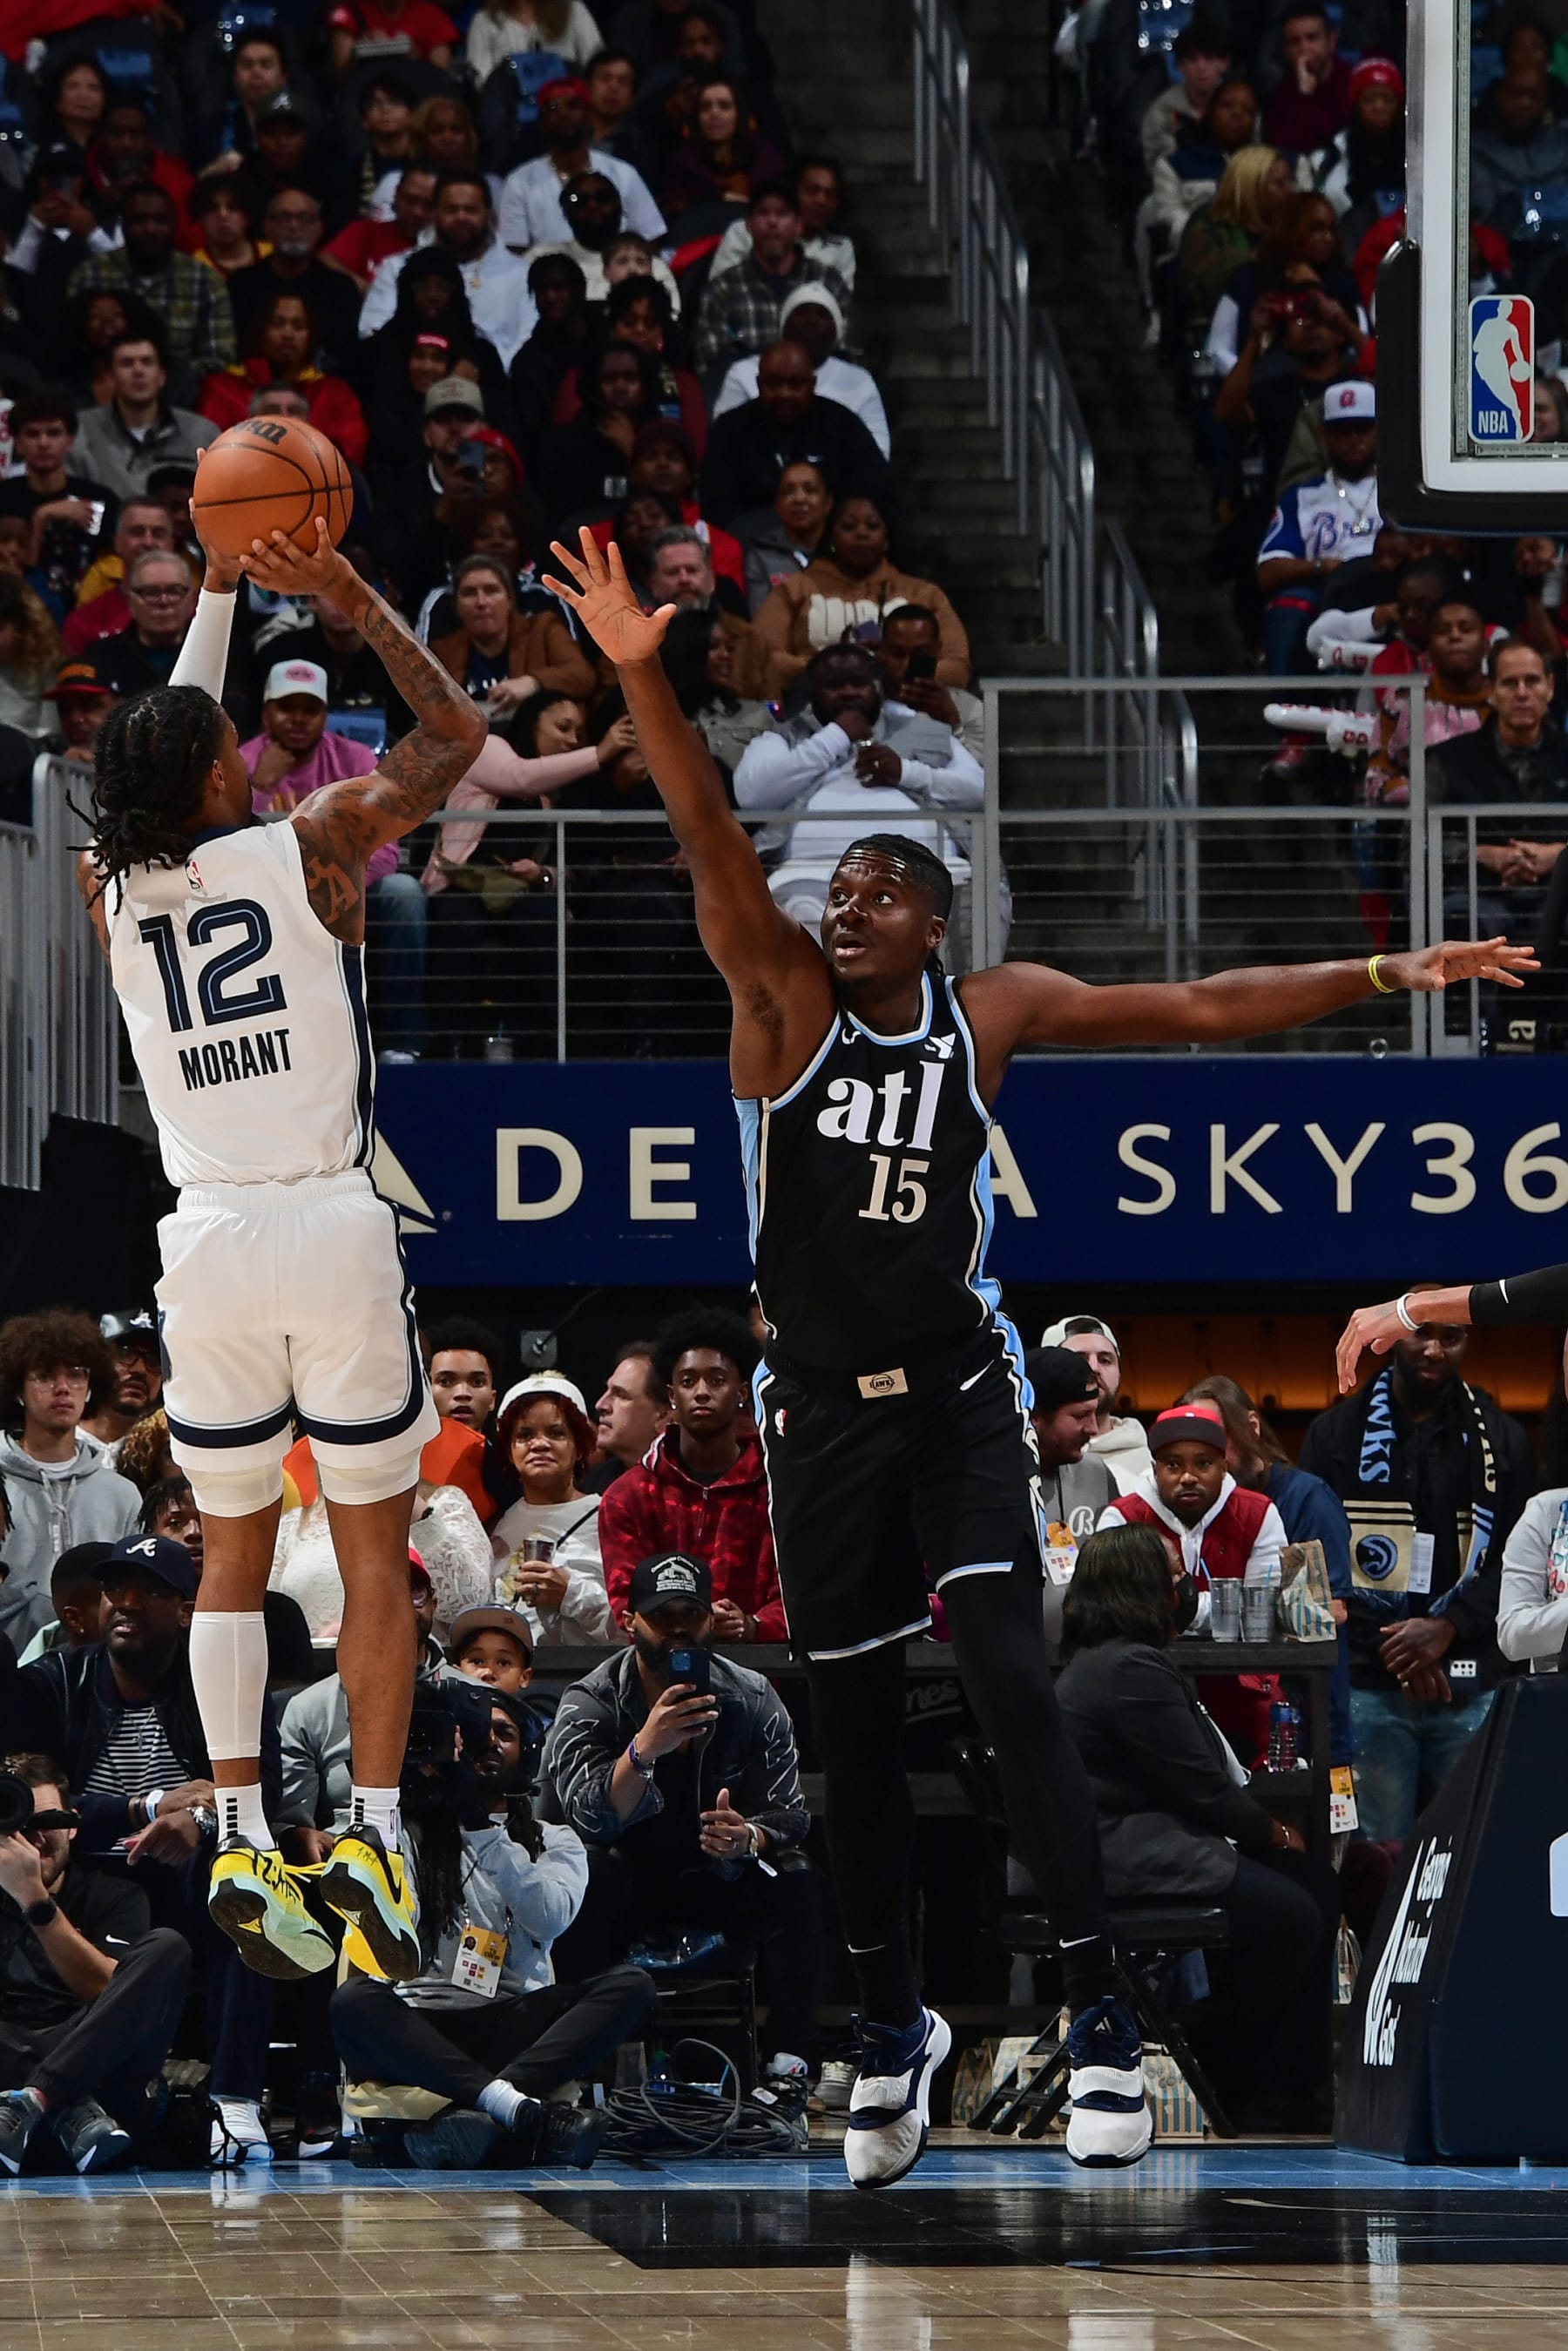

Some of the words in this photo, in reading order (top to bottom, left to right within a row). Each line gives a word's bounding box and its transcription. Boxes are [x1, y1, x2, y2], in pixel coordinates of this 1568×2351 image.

[1478, 410, 1509, 434] NBA
[138, 898, 287, 1033] 12
[178, 1029, 292, 1091] MORANT
[816, 1060, 946, 1152] atl
[858, 1153, 930, 1224] 15
[125, 1537, 158, 1557] A
